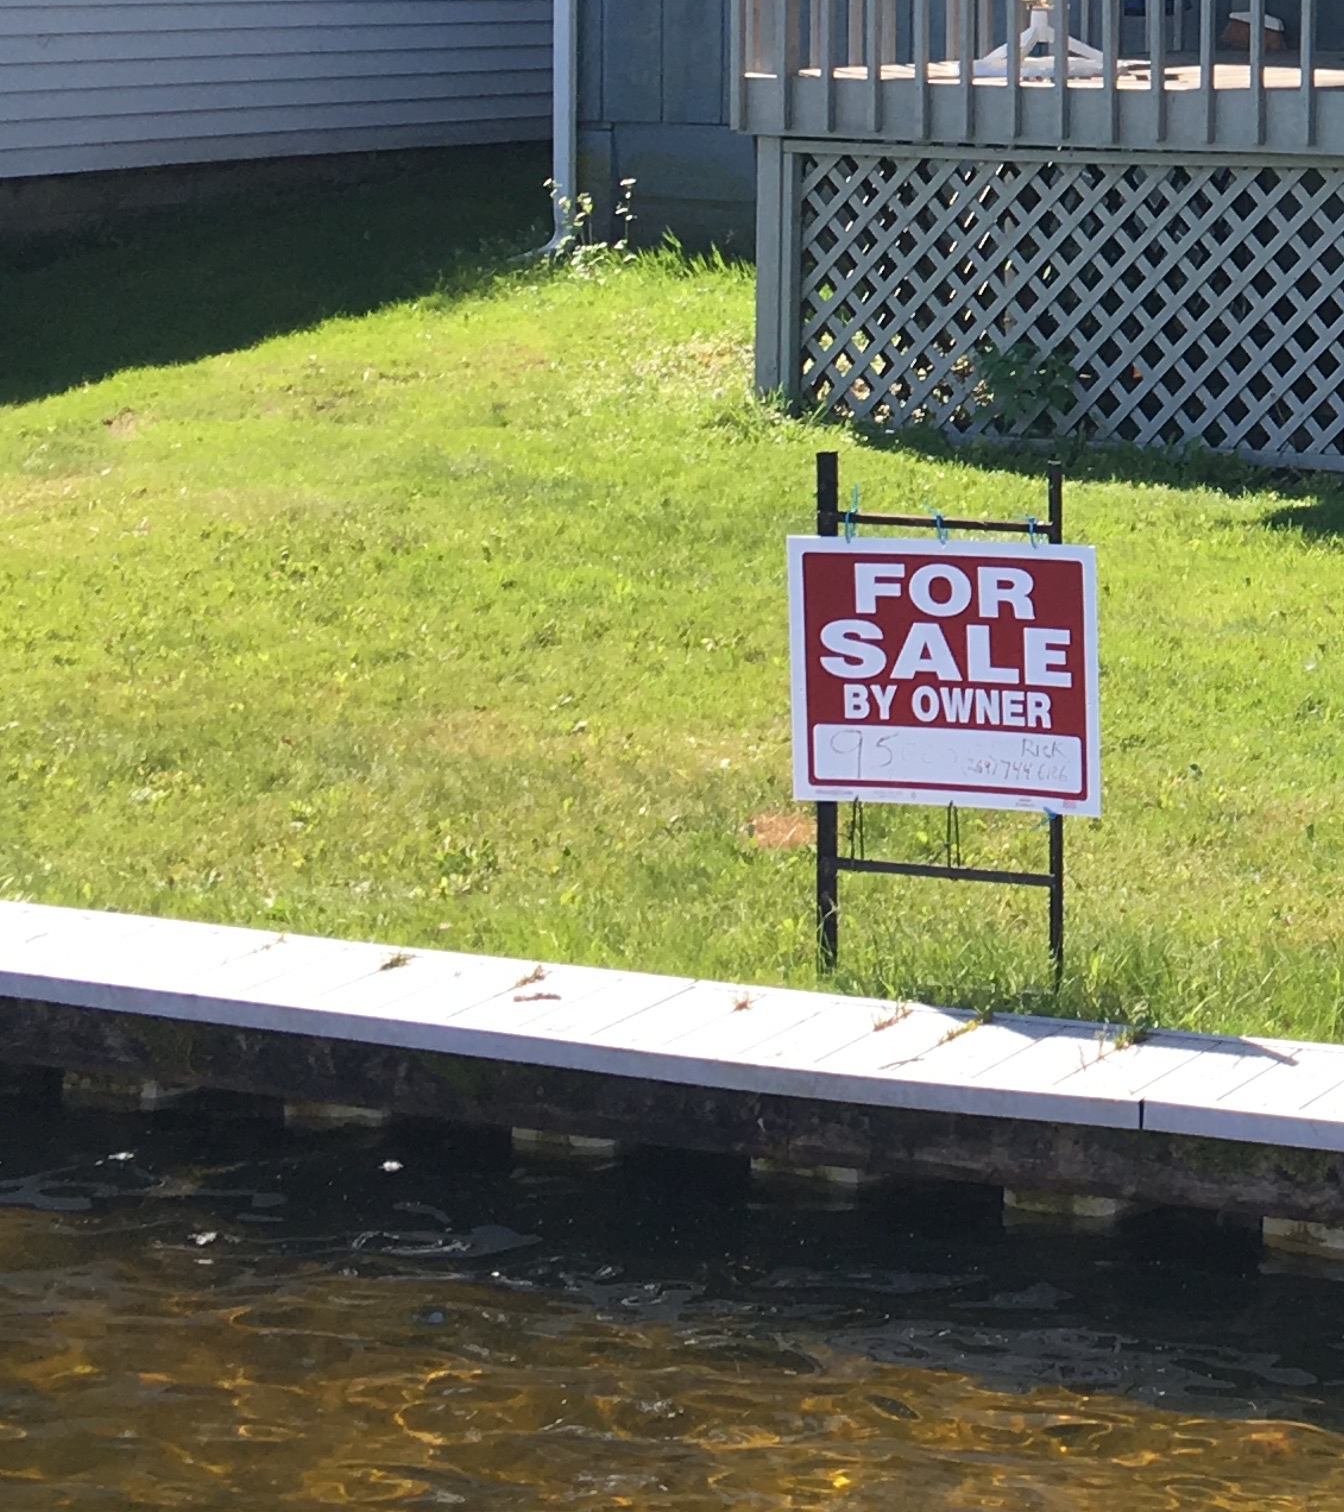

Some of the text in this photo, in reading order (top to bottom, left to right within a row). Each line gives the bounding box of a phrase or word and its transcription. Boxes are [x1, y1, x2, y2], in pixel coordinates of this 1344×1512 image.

[854, 562, 1036, 620] FOR
[819, 619, 1073, 688] SALE
[843, 683, 1052, 729] BY OWNER
